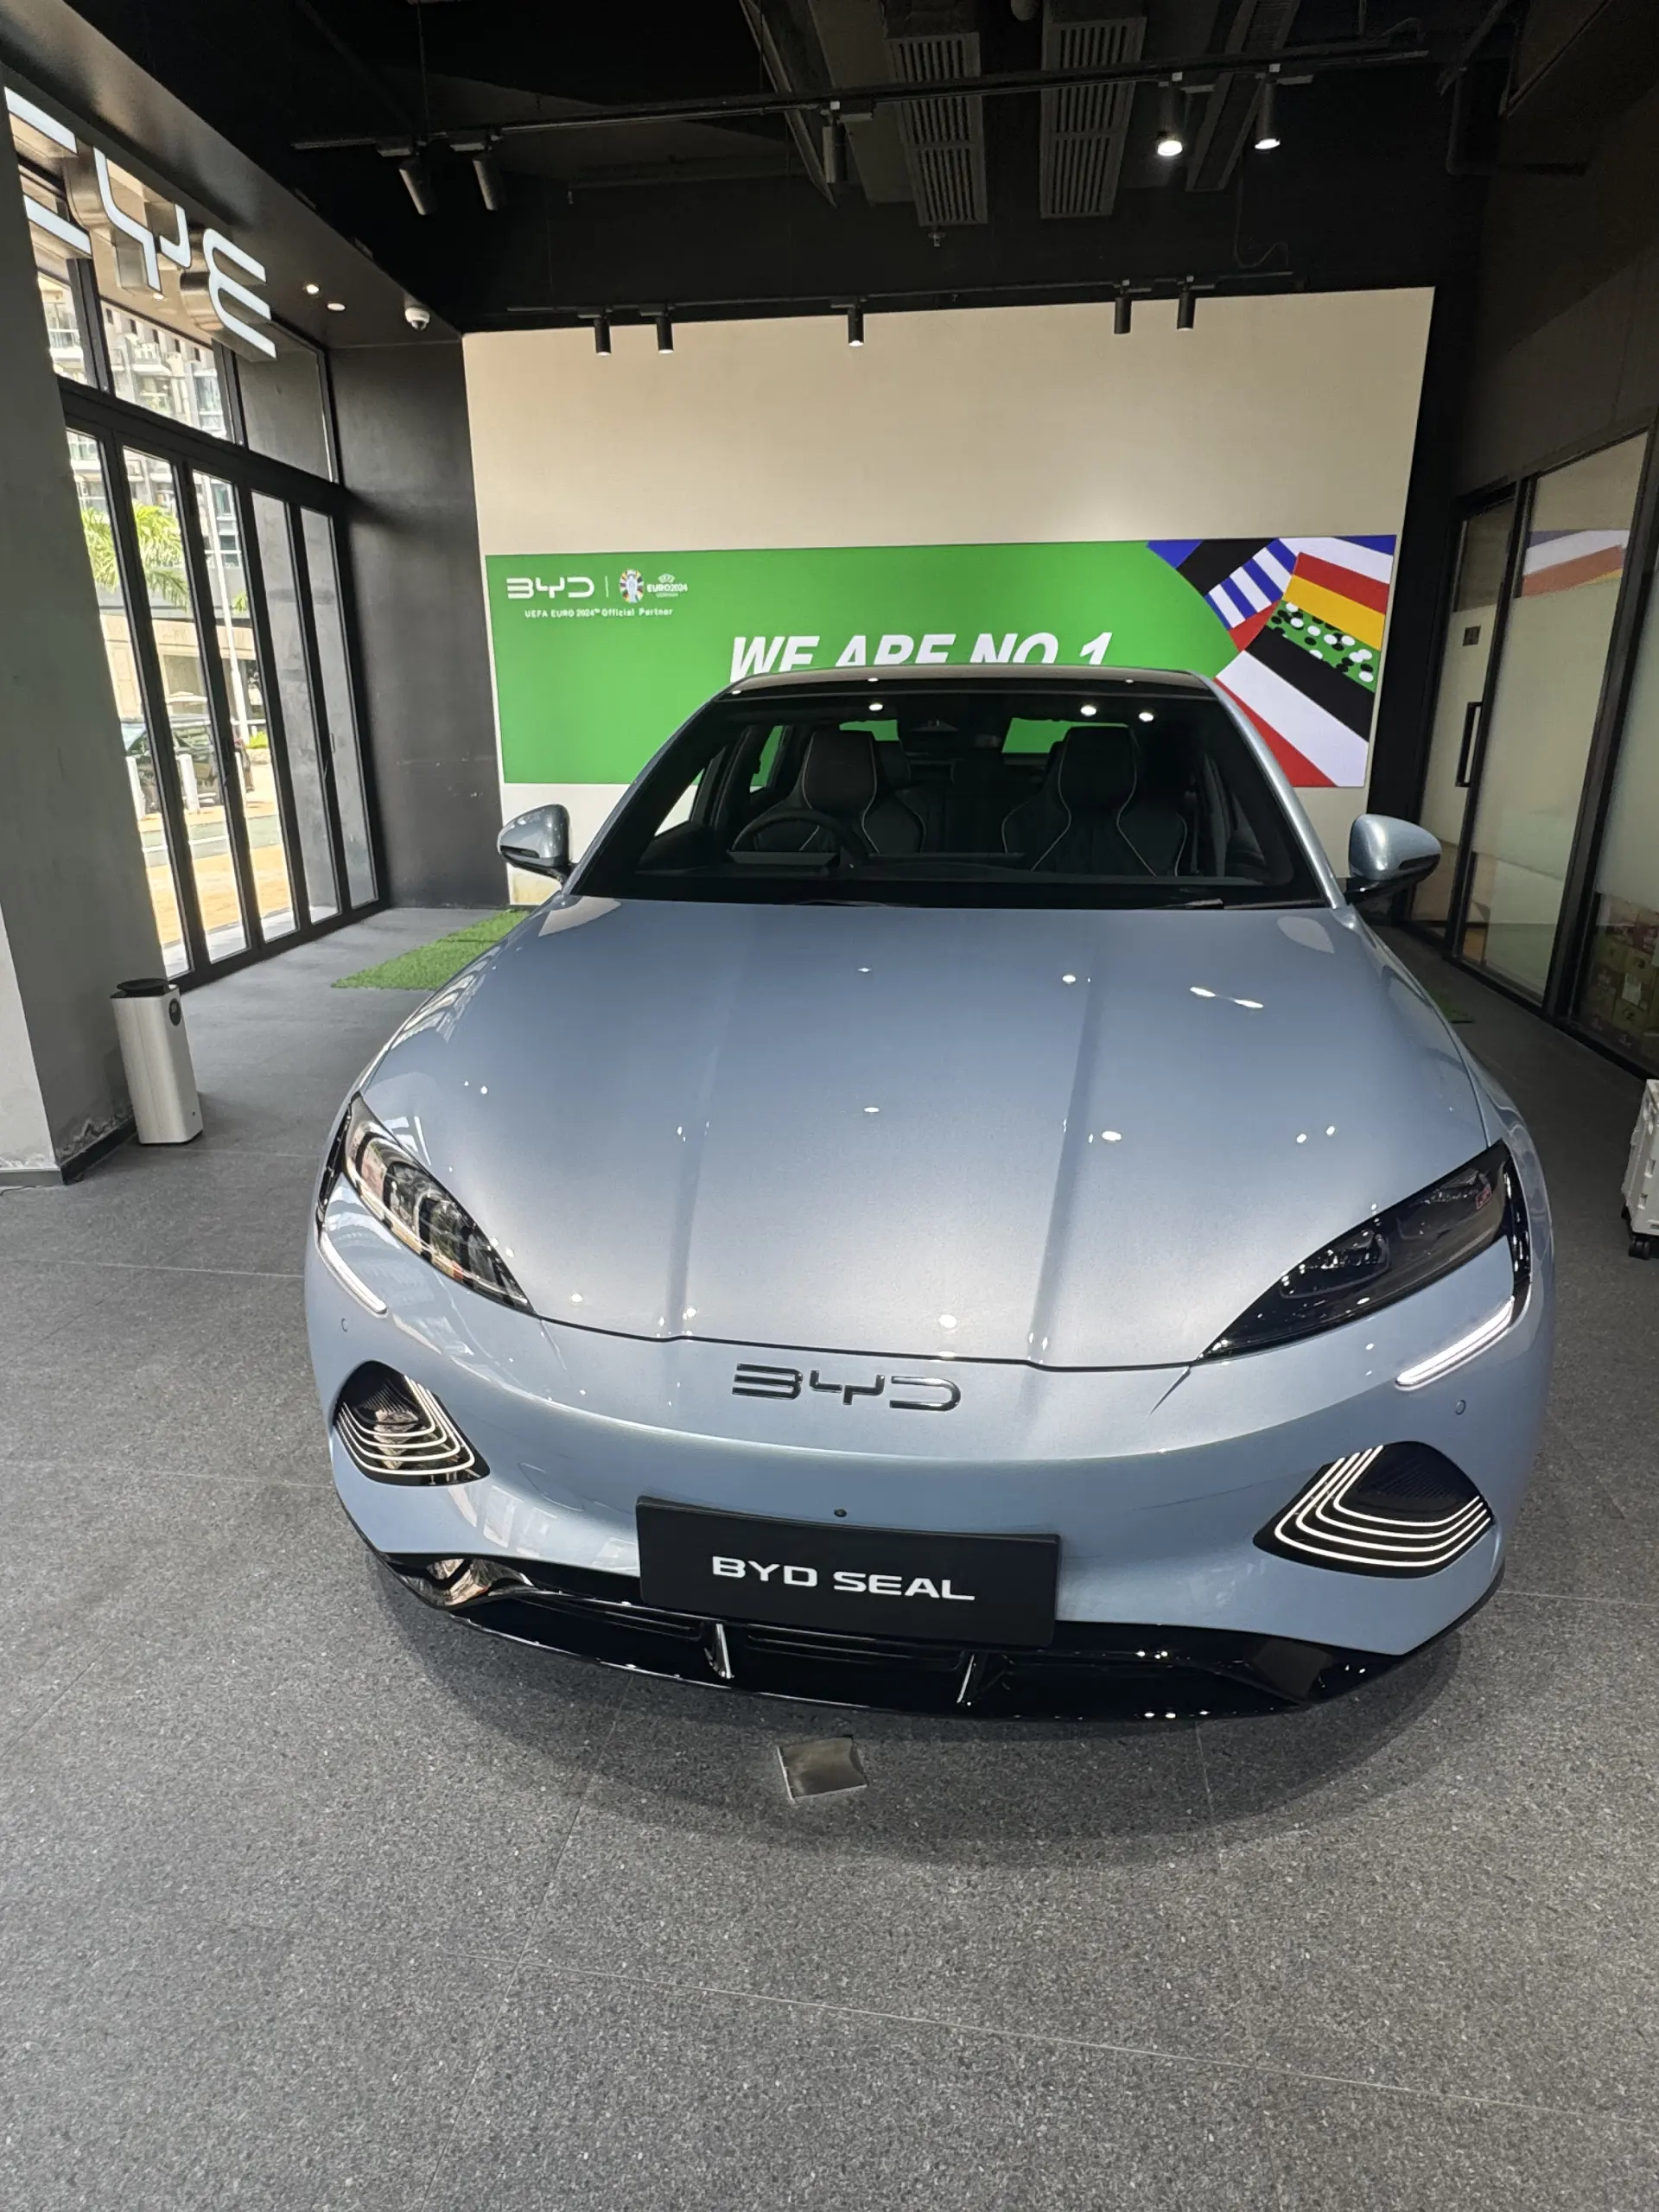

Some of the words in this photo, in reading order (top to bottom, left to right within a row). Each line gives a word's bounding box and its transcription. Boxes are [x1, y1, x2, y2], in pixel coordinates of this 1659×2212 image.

[505, 576, 594, 599] BYD
[524, 609, 548, 619] UEFA
[550, 608, 575, 618] EURO
[601, 607, 635, 617] Official
[639, 607, 673, 616] Partner
[730, 636, 820, 683] WE
[835, 633, 957, 667] ARE
[732, 1363, 962, 1412] BYD
[712, 1556, 817, 1588] BYD
[833, 1571, 976, 1601] SEAL
